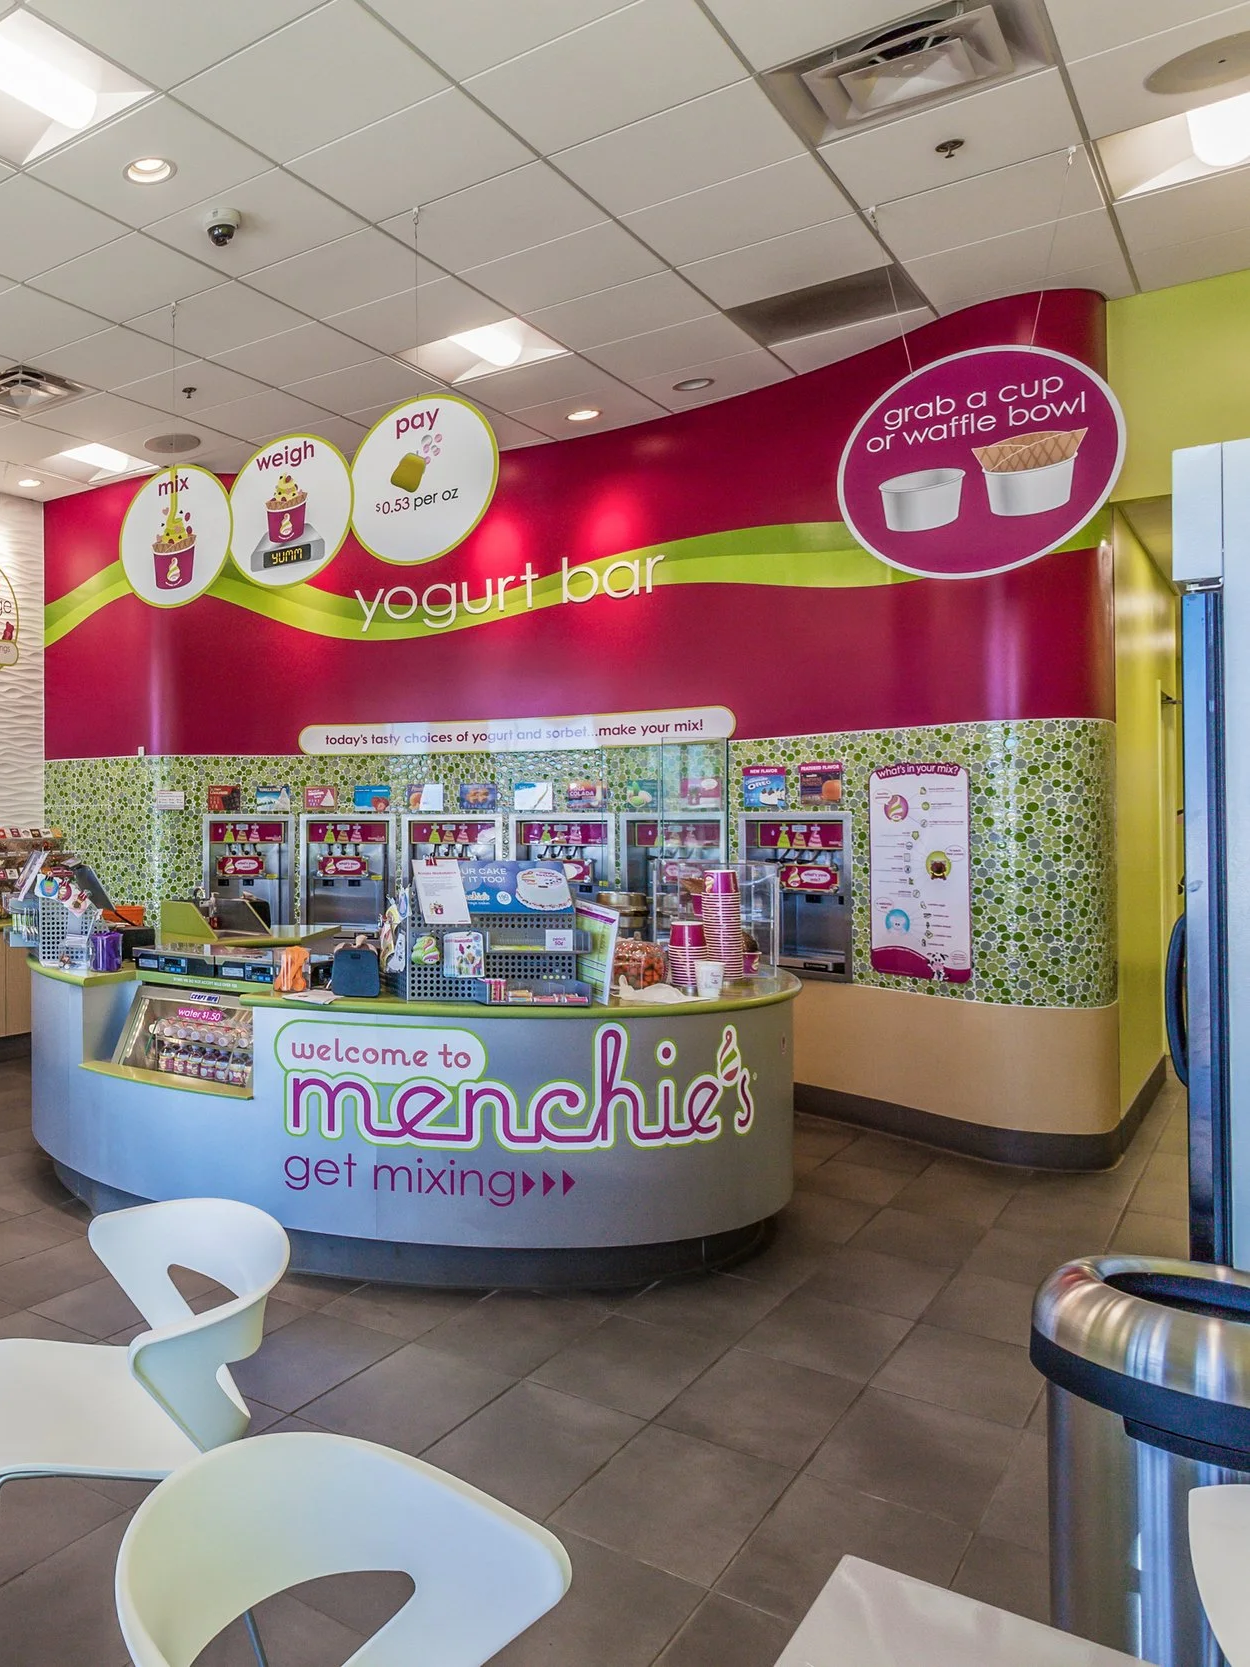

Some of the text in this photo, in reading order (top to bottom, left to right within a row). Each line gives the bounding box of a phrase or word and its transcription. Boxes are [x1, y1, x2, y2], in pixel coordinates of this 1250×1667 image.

[884, 376, 1064, 431] grab a cup
[395, 407, 440, 439] pay
[866, 391, 1086, 453] or waffle bowl
[256, 440, 316, 475] weigh
[157, 473, 190, 497] mix
[375, 486, 459, 516] $0.53 per oz
[271, 548, 303, 565] YUMM
[354, 554, 666, 633] yogurt bar
[325, 733, 368, 747] today's
[371, 732, 401, 746] tasty
[403, 730, 453, 744] choices
[456, 730, 469, 743] of
[472, 728, 513, 745] yogurt
[516, 727, 541, 741] and
[640, 721, 670, 738] your
[674, 718, 704, 732] mix!
[877, 764, 959, 778] what's in your mix?
[178, 1008, 221, 1021] water $1.50
[290, 1038, 472, 1070] welcome to
[289, 1023, 753, 1147] menchie's
[283, 1152, 517, 1207] get mixing
